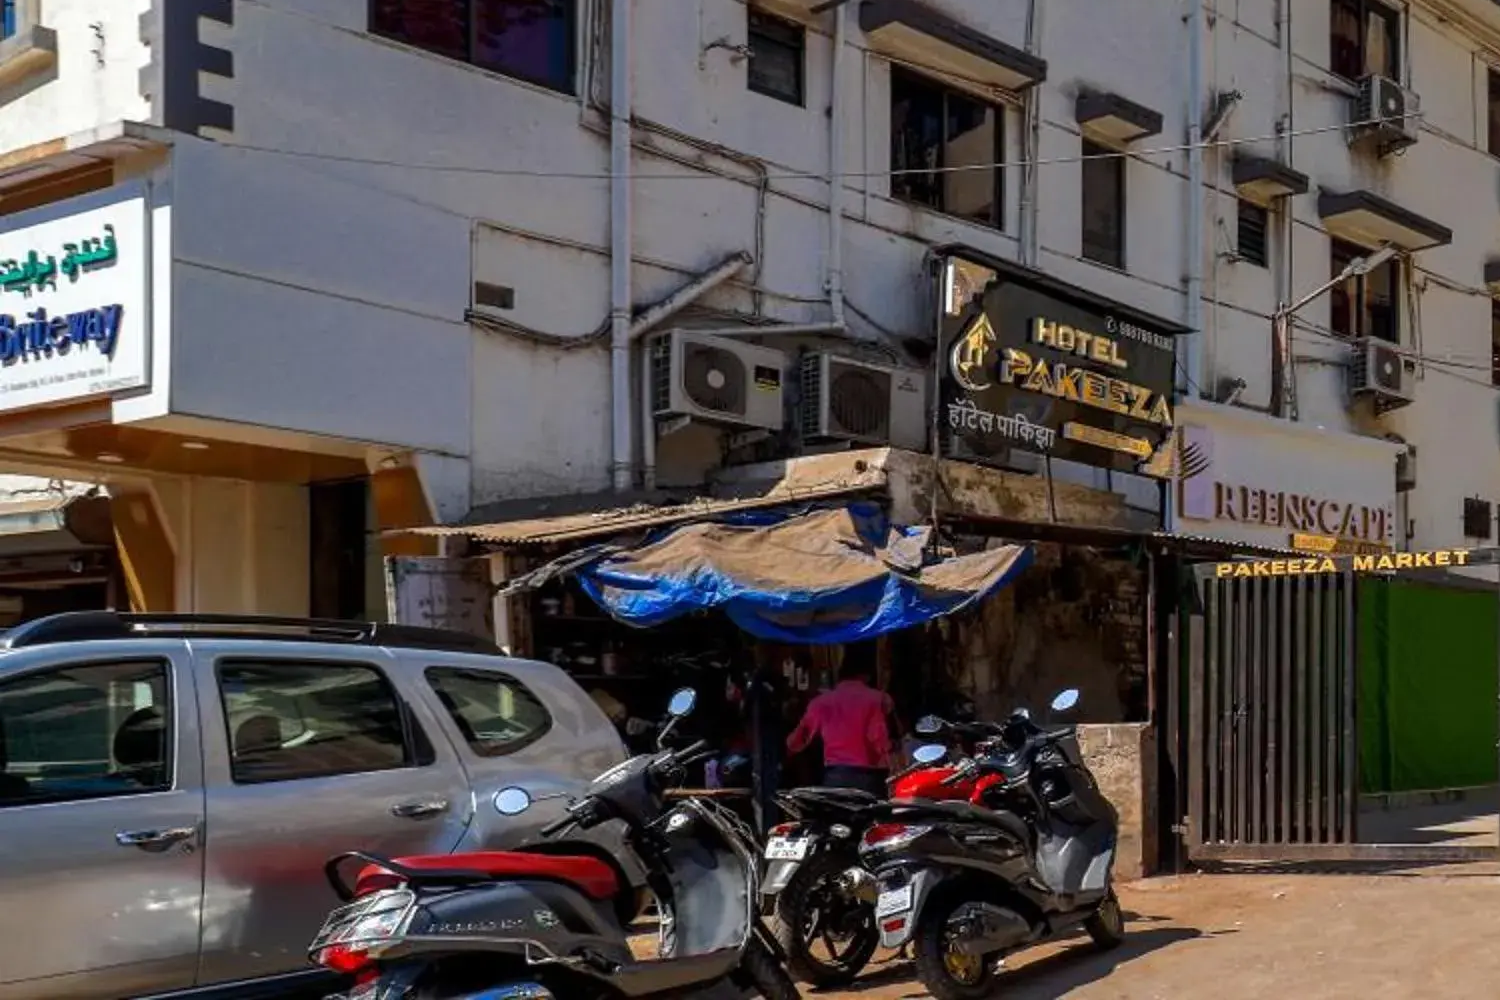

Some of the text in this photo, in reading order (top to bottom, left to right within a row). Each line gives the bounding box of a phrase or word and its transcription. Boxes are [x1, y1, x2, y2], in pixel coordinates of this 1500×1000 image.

[1033, 316, 1129, 369] HOTEL
[1000, 347, 1174, 429] PAKEEZA
[1216, 550, 1469, 578] PAKEEZA MARKET
